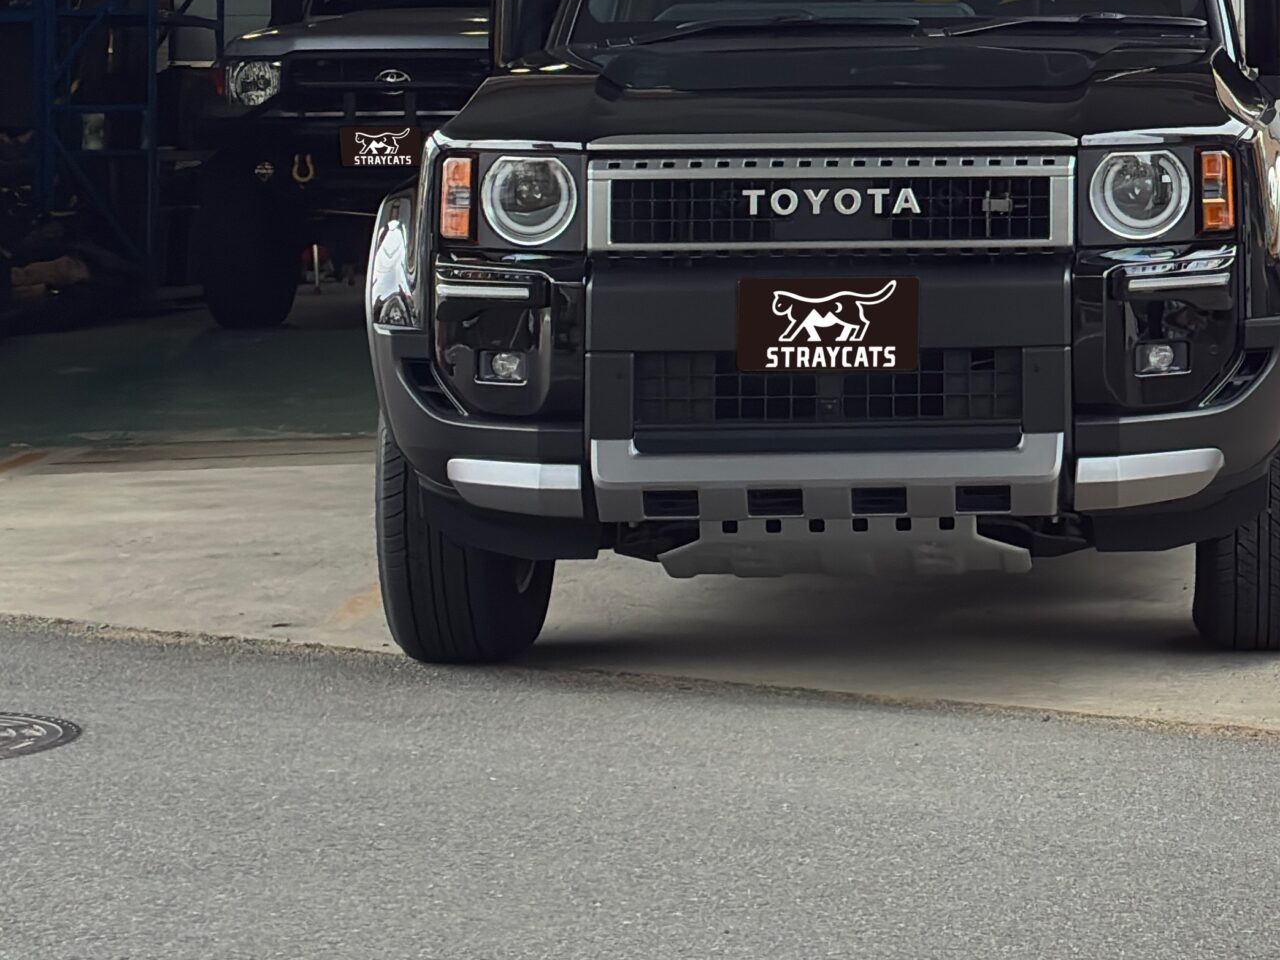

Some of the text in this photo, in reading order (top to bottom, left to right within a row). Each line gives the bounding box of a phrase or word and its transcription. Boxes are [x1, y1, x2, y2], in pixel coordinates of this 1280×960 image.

[354, 155, 412, 166] STRAYCATS
[742, 188, 921, 215] TOYOTA
[765, 346, 896, 368] STRAYCATS
